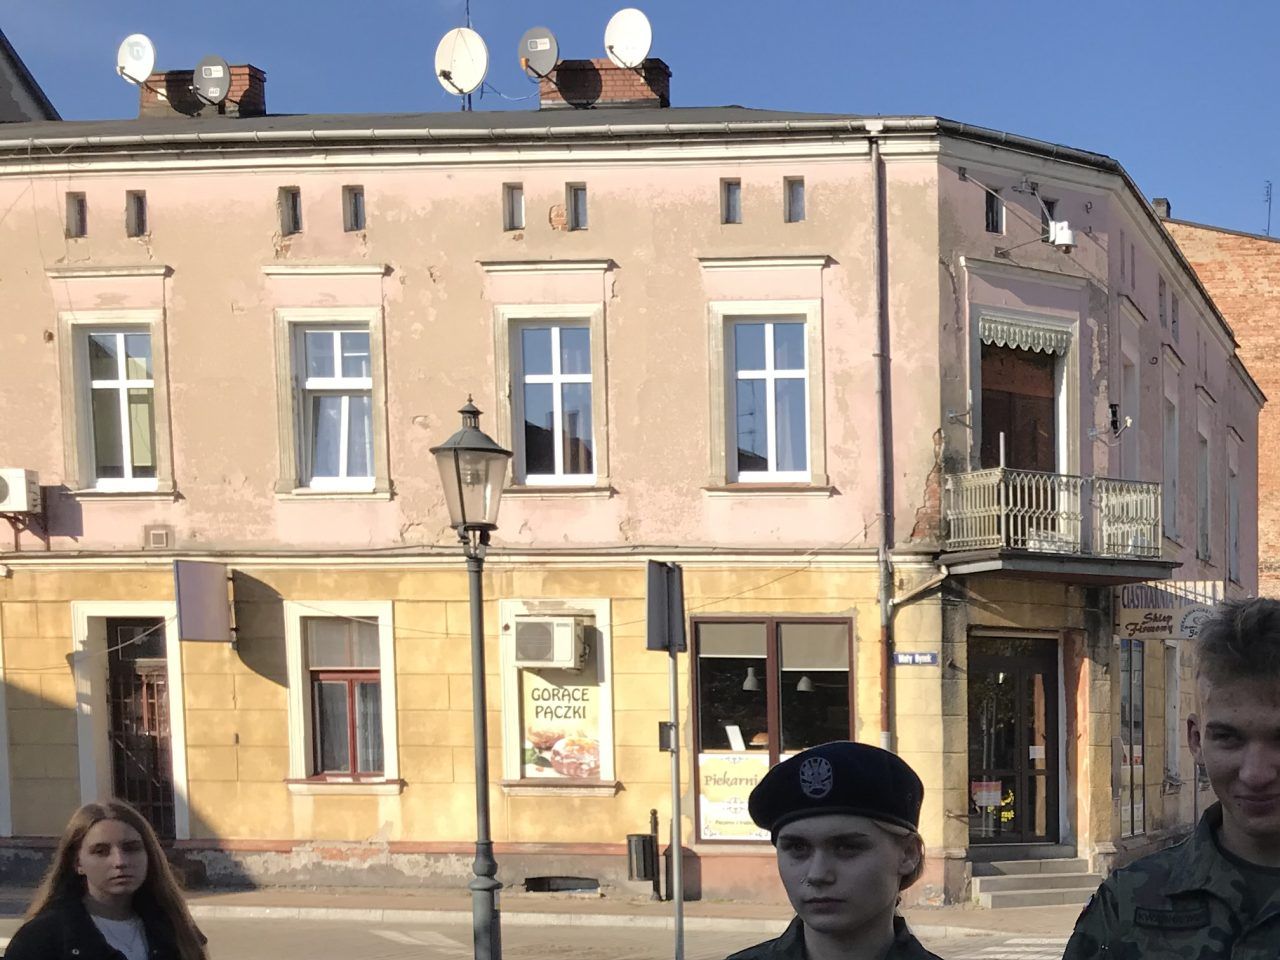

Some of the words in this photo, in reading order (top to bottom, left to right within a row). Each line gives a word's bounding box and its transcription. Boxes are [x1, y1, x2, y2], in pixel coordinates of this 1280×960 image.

[531, 688, 589, 704] GORĄCE
[535, 705, 586, 722] PĄCZKI
[704, 771, 759, 787] Piekarni
